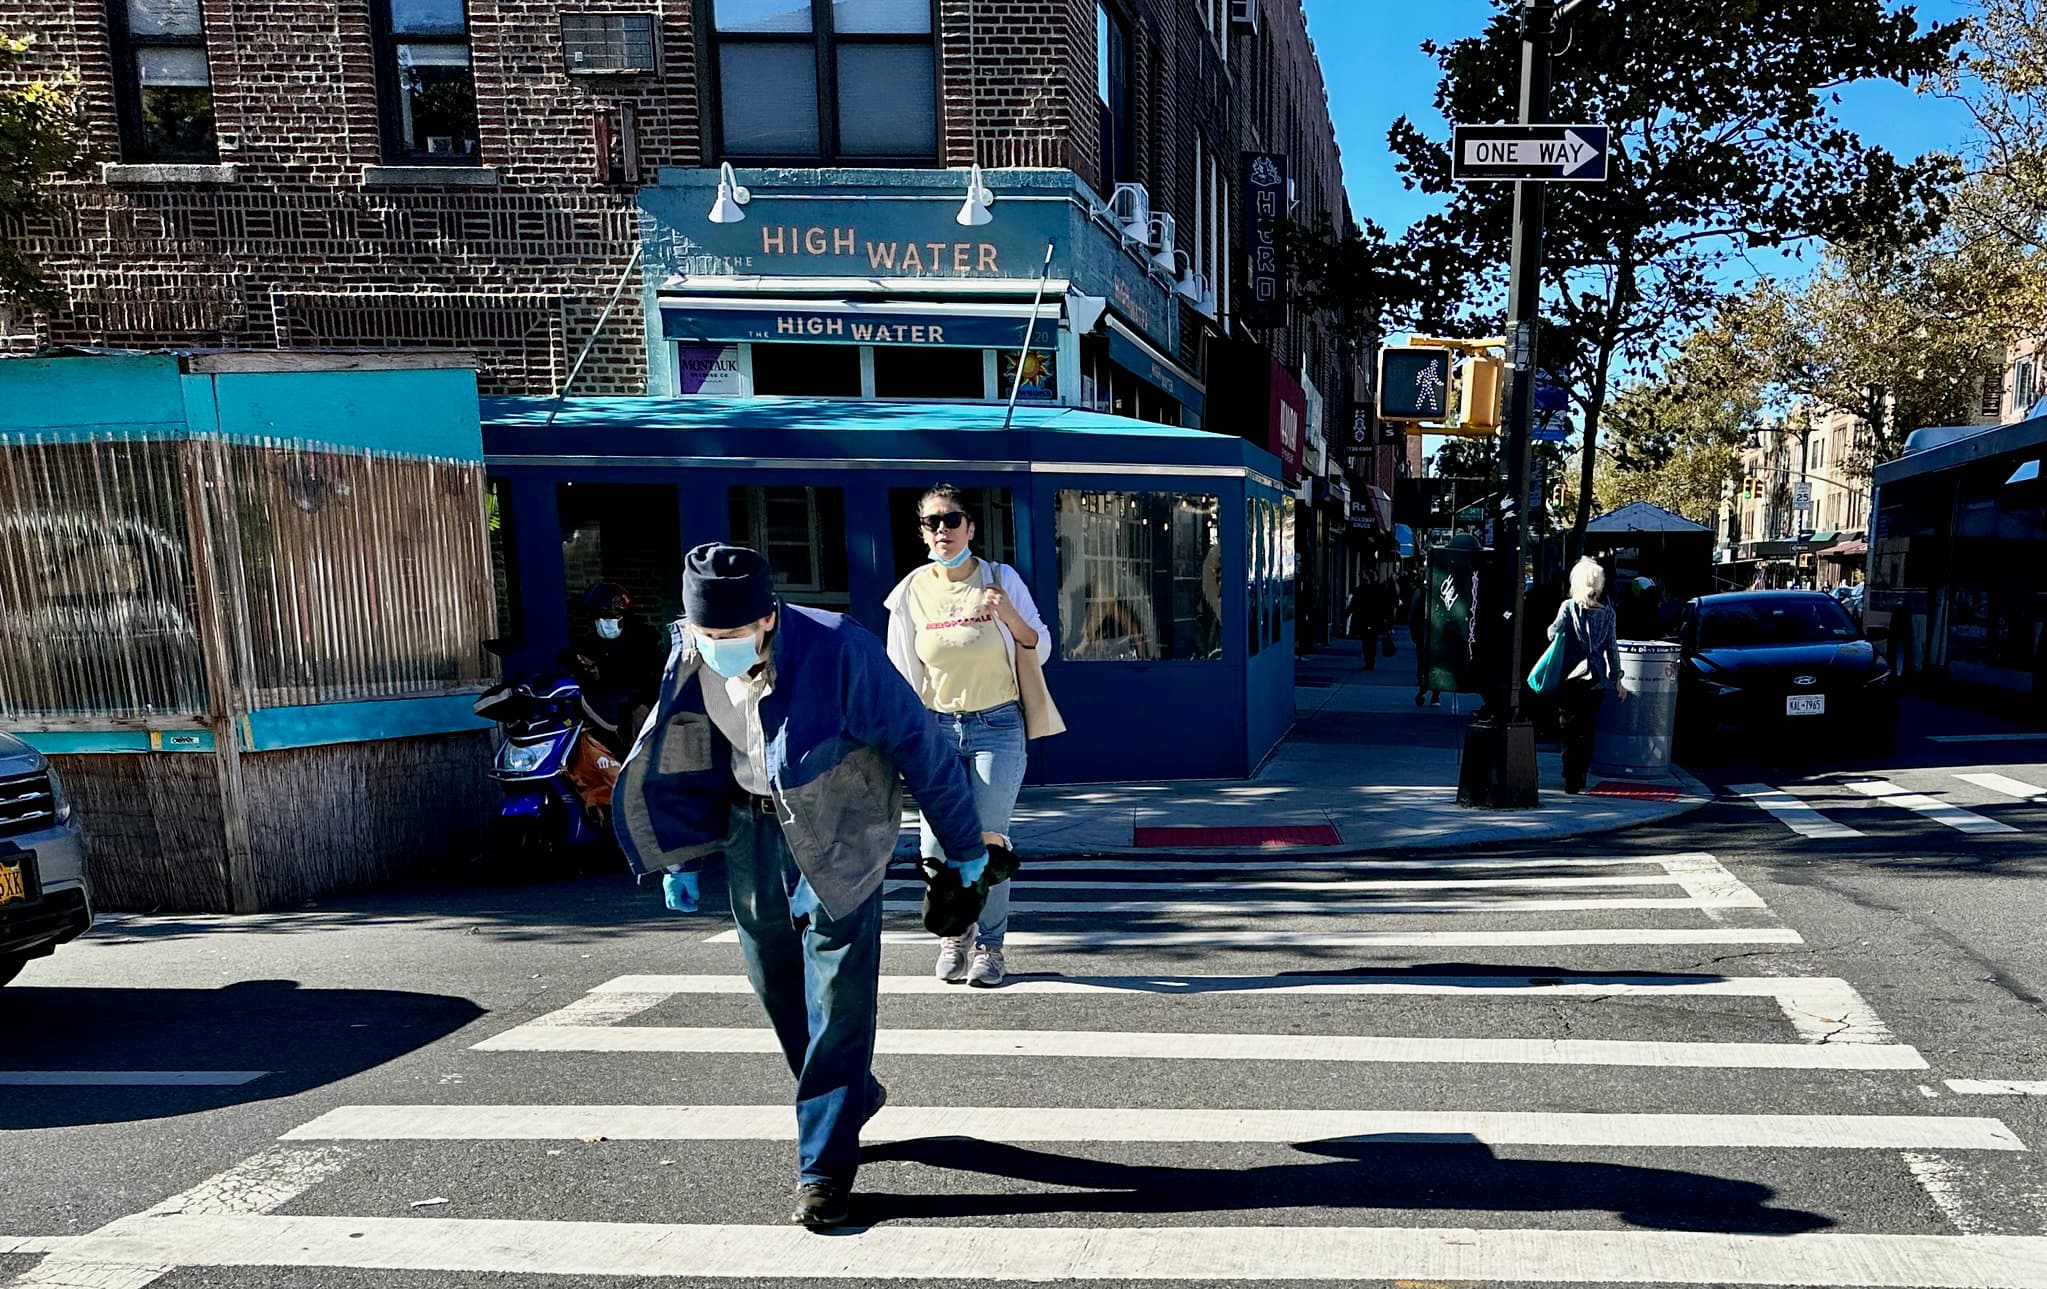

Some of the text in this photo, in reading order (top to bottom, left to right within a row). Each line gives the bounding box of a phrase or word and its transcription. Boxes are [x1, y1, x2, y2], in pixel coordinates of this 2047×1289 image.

[1475, 142, 1584, 163] ONE WAY
[724, 225, 1000, 273] THE HIGH WATER
[748, 317, 944, 343] THE HIGH WATER
[682, 360, 737, 371] MONTAUK
[1796, 493, 1809, 502] 25
[1351, 501, 1367, 512] Rx
